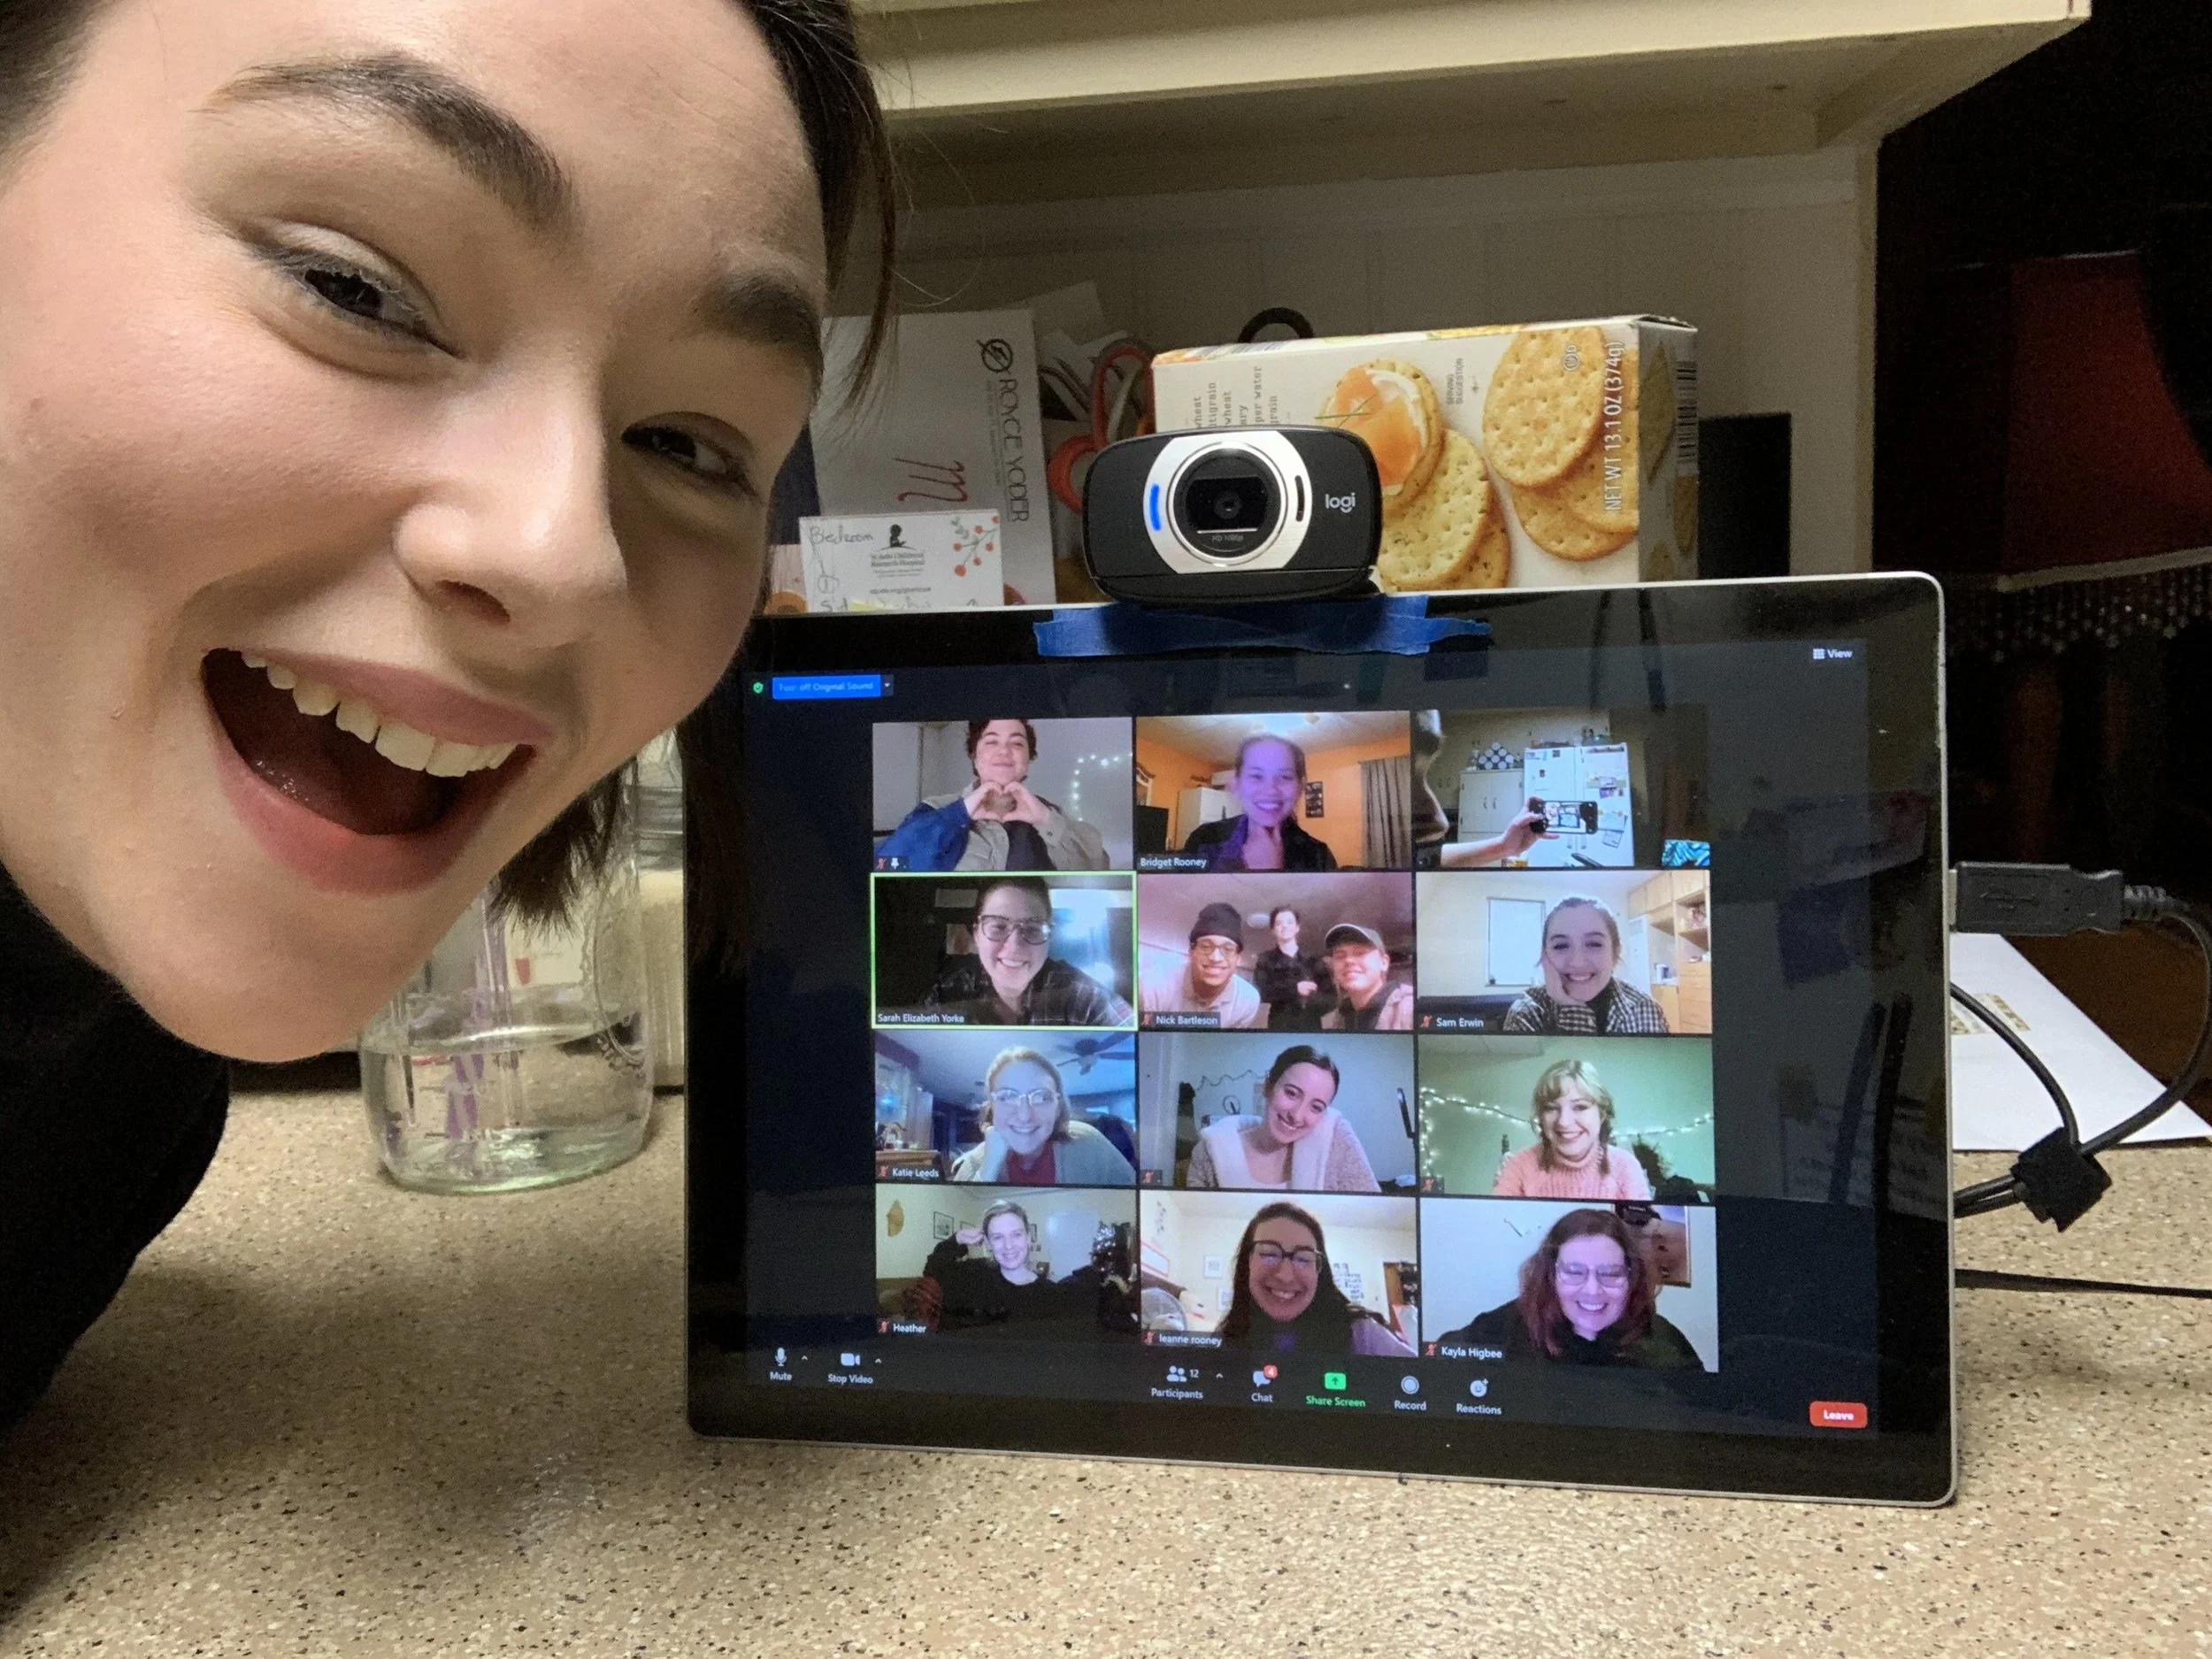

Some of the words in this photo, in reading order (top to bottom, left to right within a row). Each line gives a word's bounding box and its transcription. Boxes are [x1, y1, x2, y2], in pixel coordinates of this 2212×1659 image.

[1604, 341, 1624, 391] (374g)
[1253, 365, 1262, 399] water
[1223, 390, 1232, 426] wheat
[1603, 396, 1622, 416] OZ
[999, 379, 1023, 449] ROYCE
[1604, 420, 1622, 451] 13.1
[1604, 457, 1622, 482] WT
[1004, 456, 1029, 523] YODER
[1325, 491, 1356, 513] logi
[1604, 483, 1622, 511] NET
[1826, 649, 1854, 659] View
[847, 681, 874, 691] Sound
[1140, 856, 1172, 870] Bridget
[1173, 856, 1207, 869] Rooney
[877, 1012, 901, 1023] Sarah
[902, 1012, 940, 1024] Elizabeth
[941, 1013, 965, 1024] Yorke
[1156, 1015, 1176, 1025] Nick
[1178, 1015, 1218, 1025] Bartleson
[1436, 1017, 1457, 1027] Sam
[1458, 1017, 1485, 1028] Erwin
[892, 1167, 913, 1178] Katie
[915, 1168, 940, 1179] Leeds
[893, 1323, 927, 1333] Heather
[1190, 1336, 1223, 1348] rooney
[1441, 1346, 1467, 1359] Kayla
[1468, 1347, 1502, 1361] Higbee
[769, 1371, 794, 1381] Mute
[827, 1372, 848, 1386] Stop
[849, 1373, 874, 1385] Video
[1189, 1369, 1200, 1379] 12
[1151, 1386, 1203, 1400] Participants
[1251, 1392, 1273, 1403] Chat
[1305, 1394, 1332, 1407] Share
[1333, 1396, 1366, 1408] Screen
[1394, 1399, 1427, 1411] Record
[1455, 1402, 1502, 1415] Reactions
[1823, 1409, 1855, 1421] Leave
